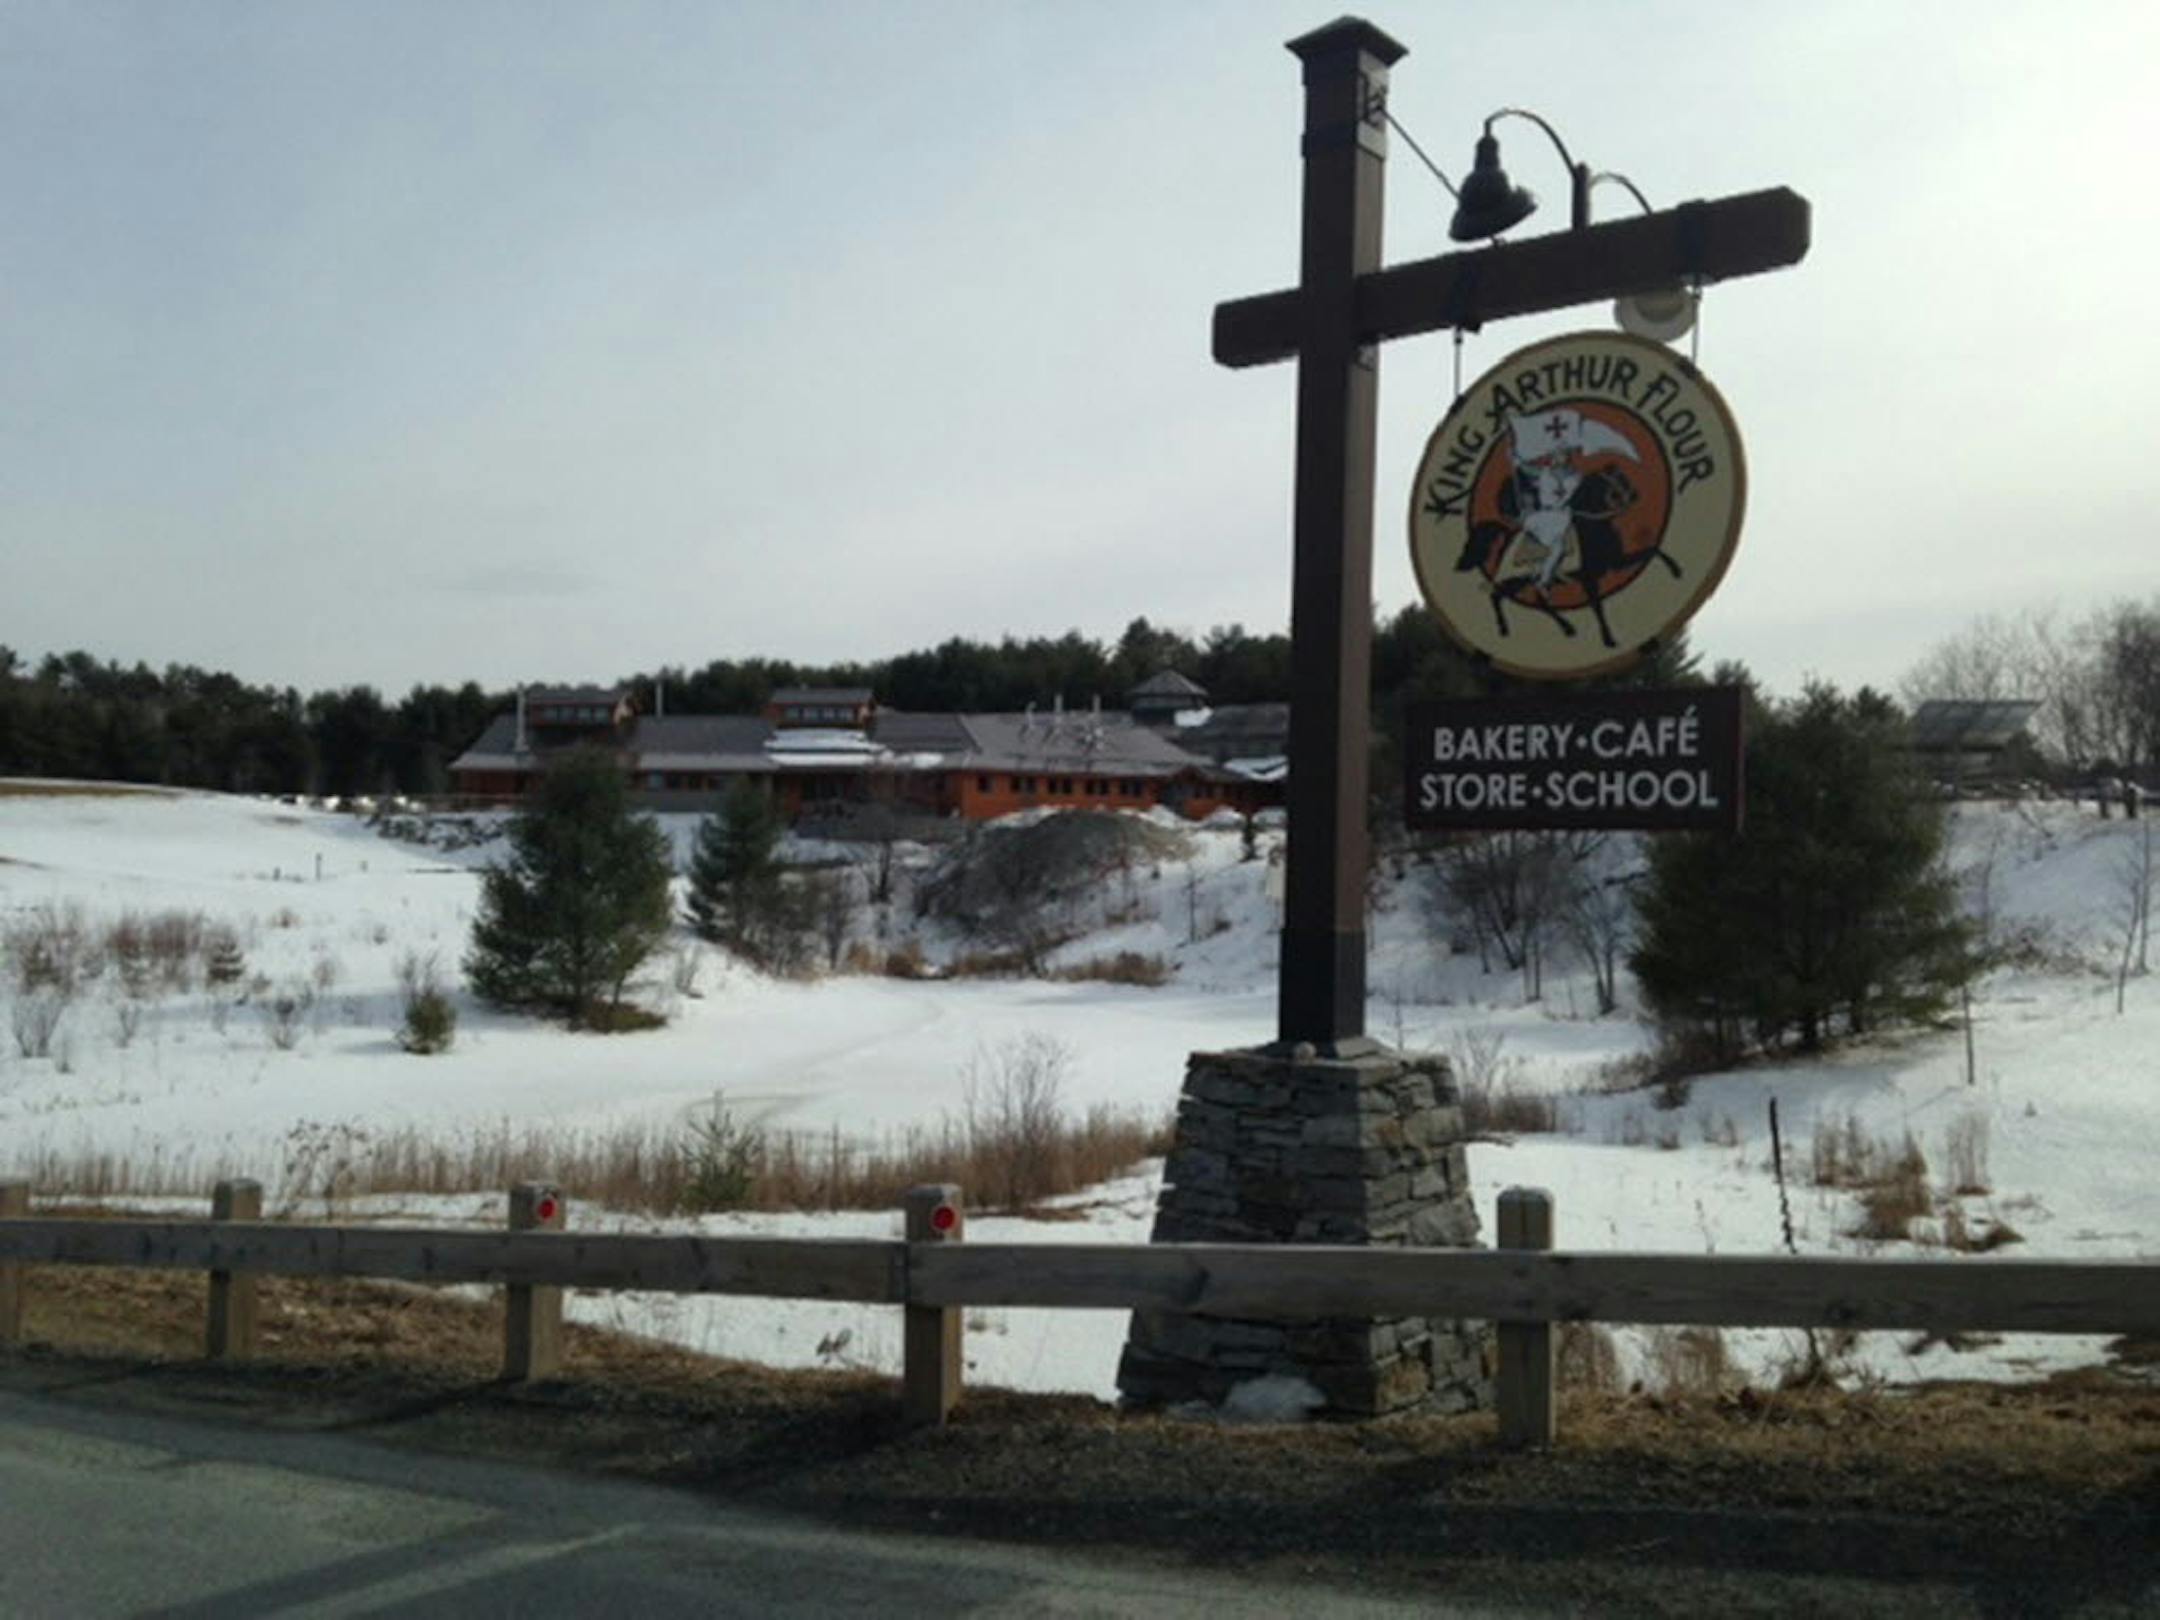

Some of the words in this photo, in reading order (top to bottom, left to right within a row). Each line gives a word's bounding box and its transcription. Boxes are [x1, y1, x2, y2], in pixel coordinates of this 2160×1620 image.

[1424, 425, 1486, 523] KING
[1485, 355, 1640, 435] ARTHUR
[1636, 371, 1716, 496] FLOUR
[1433, 722, 1574, 761] BAKERY
[1419, 772, 1527, 809] STORE
[1545, 769, 1720, 808] SCHOOL
